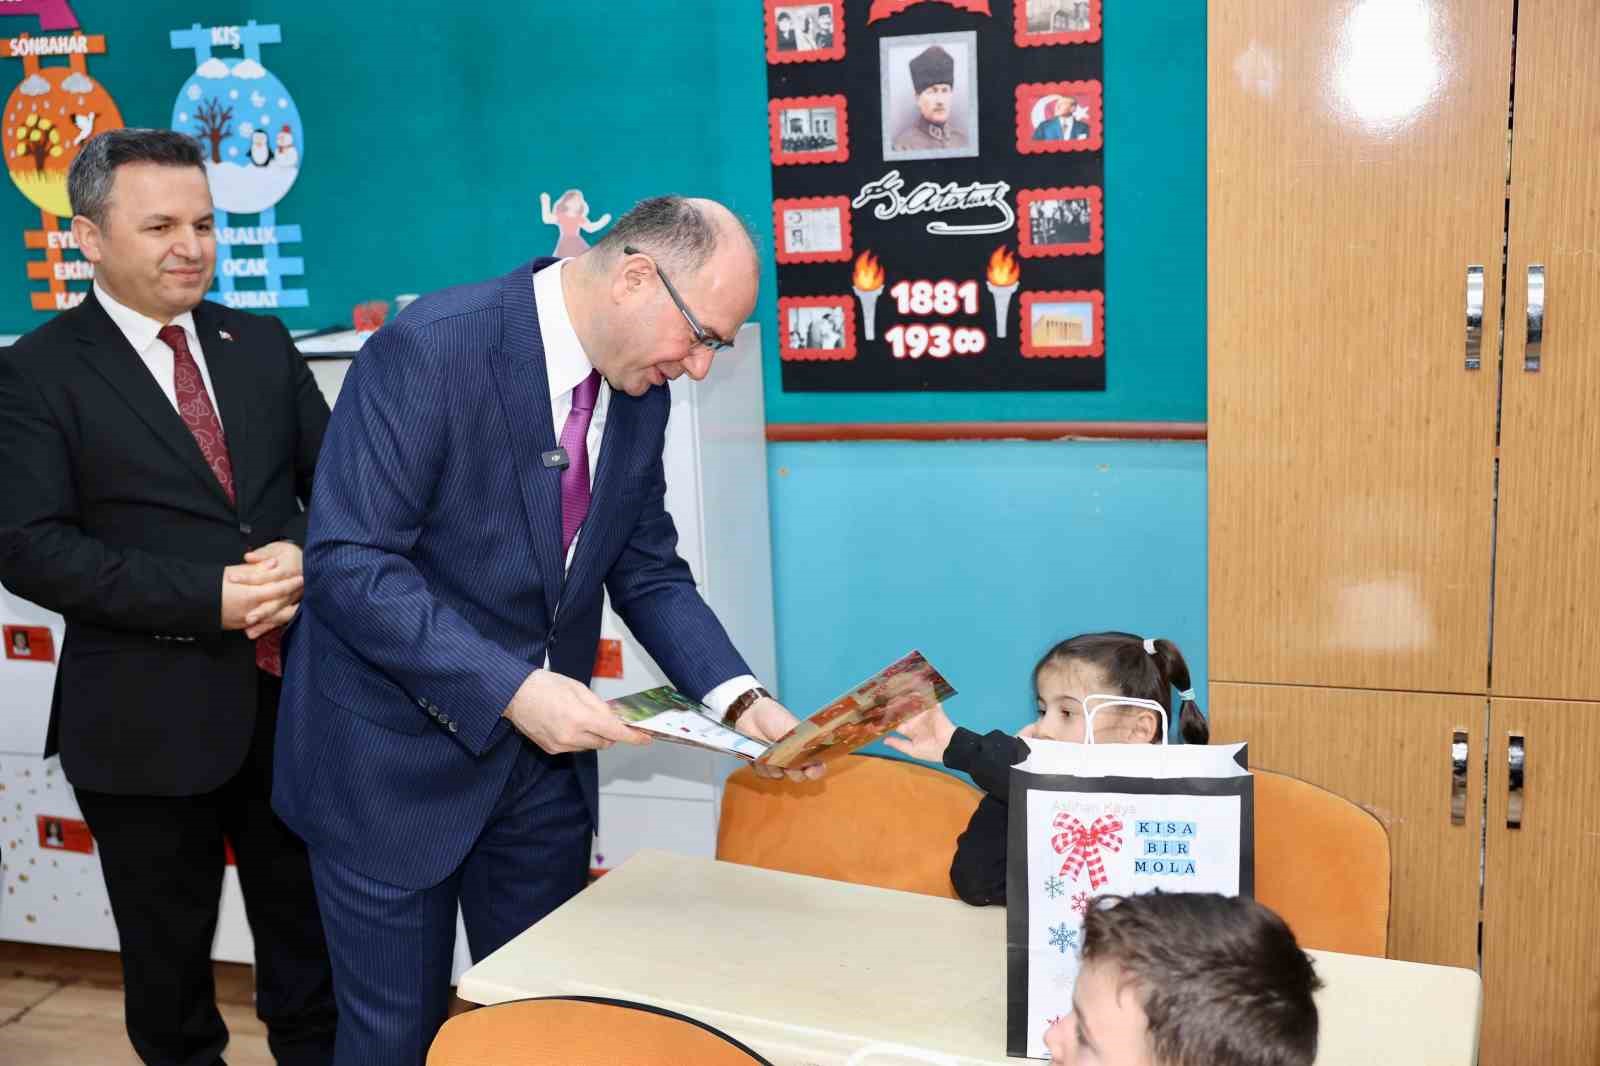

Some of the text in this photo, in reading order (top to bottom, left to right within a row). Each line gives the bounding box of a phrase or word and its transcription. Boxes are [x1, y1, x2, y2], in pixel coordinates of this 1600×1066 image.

[10, 36, 88, 56] SONBAHAR
[211, 26, 240, 49] KIŞ
[48, 231, 80, 249] EYL
[213, 226, 277, 245] ARALIK
[222, 258, 269, 277] OCAK
[890, 280, 979, 314] 1881
[1139, 822, 1193, 834] KISA
[1135, 861, 1195, 873] MOLA
